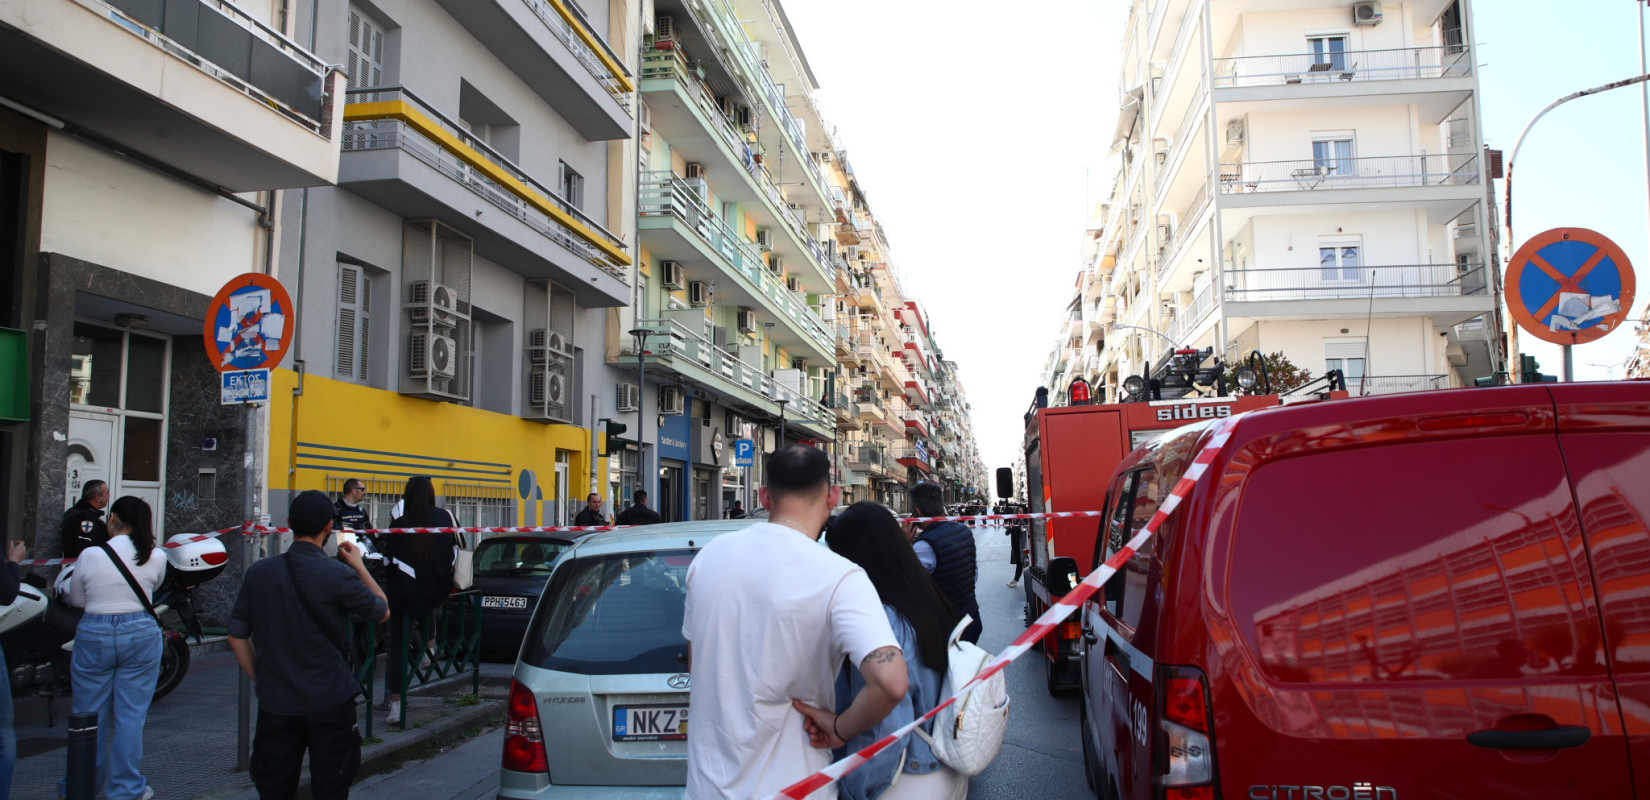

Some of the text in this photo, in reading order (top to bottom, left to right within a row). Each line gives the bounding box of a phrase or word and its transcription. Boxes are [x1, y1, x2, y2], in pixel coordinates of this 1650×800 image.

[1156, 404, 1232, 421] sides
[739, 443, 749, 456] P
[543, 696, 586, 704] HYUNDAI
[633, 710, 677, 734] NKZ
[1133, 698, 1148, 747] 199
